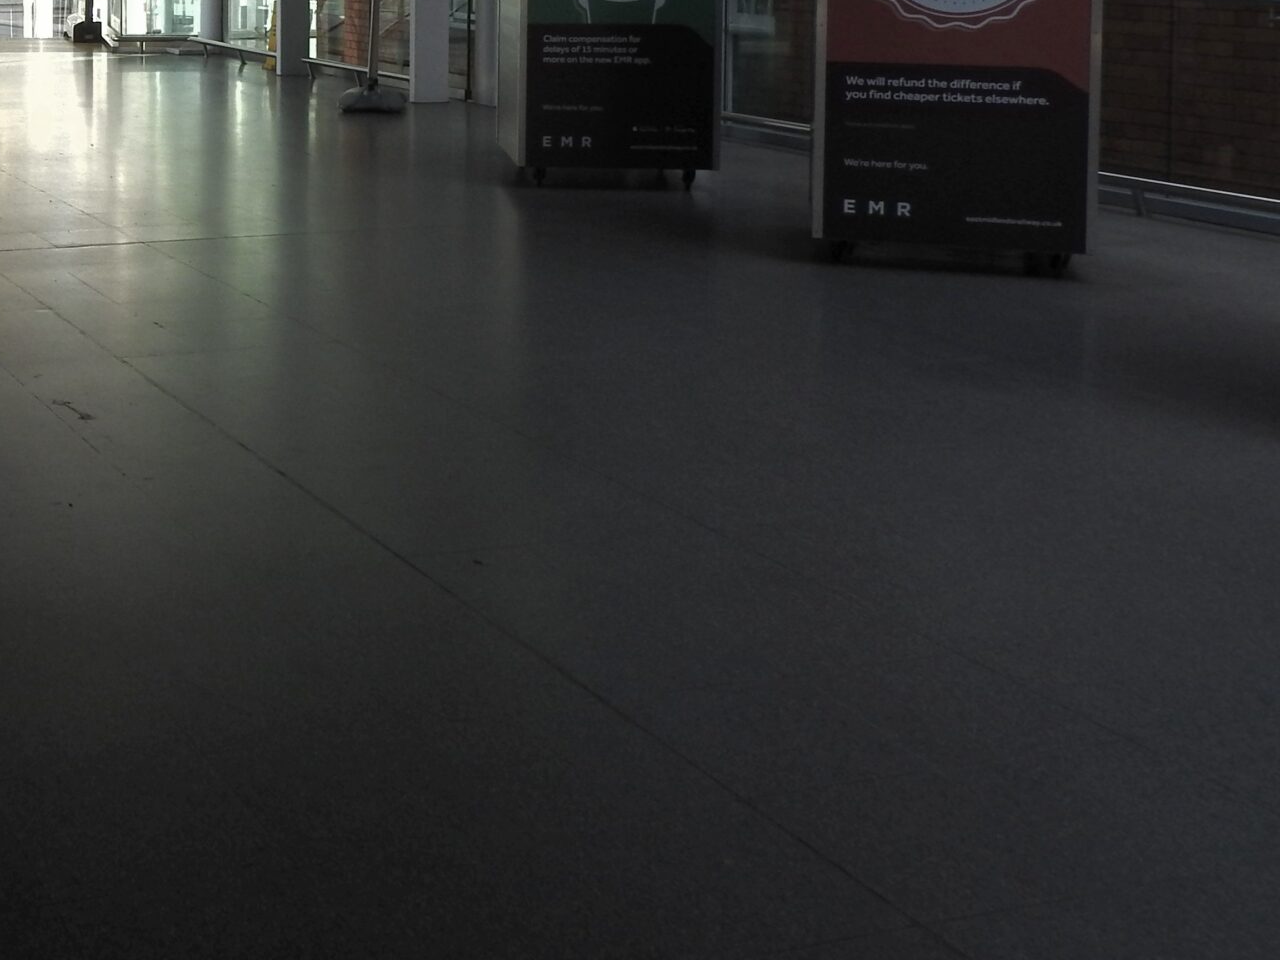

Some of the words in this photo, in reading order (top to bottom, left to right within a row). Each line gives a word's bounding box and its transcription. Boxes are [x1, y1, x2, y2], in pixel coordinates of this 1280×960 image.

[543, 34, 567, 43] Claim
[568, 35, 628, 45] compensation
[629, 35, 641, 43] for
[543, 45, 570, 55] delays
[570, 45, 581, 53] of
[593, 46, 627, 54] minutes
[543, 56, 565, 64] more
[567, 56, 578, 64] on
[579, 56, 593, 64] the
[613, 56, 633, 64] EMR
[846, 76, 865, 86] We
[866, 76, 886, 87] will
[887, 77, 926, 88] refund
[928, 78, 948, 89] the
[950, 79, 1010, 91] difference
[1012, 80, 1022, 91] if
[845, 92, 867, 101] you
[868, 90, 891, 100] find
[893, 91, 939, 104] cheaper
[942, 92, 983, 104] tickets
[985, 94, 1050, 106] elsewhere.
[542, 136, 593, 148] EMR
[843, 158, 870, 168] We're
[871, 159, 893, 169] here
[893, 160, 907, 169] for
[908, 162, 929, 172] you.
[843, 199, 912, 217] EMR
